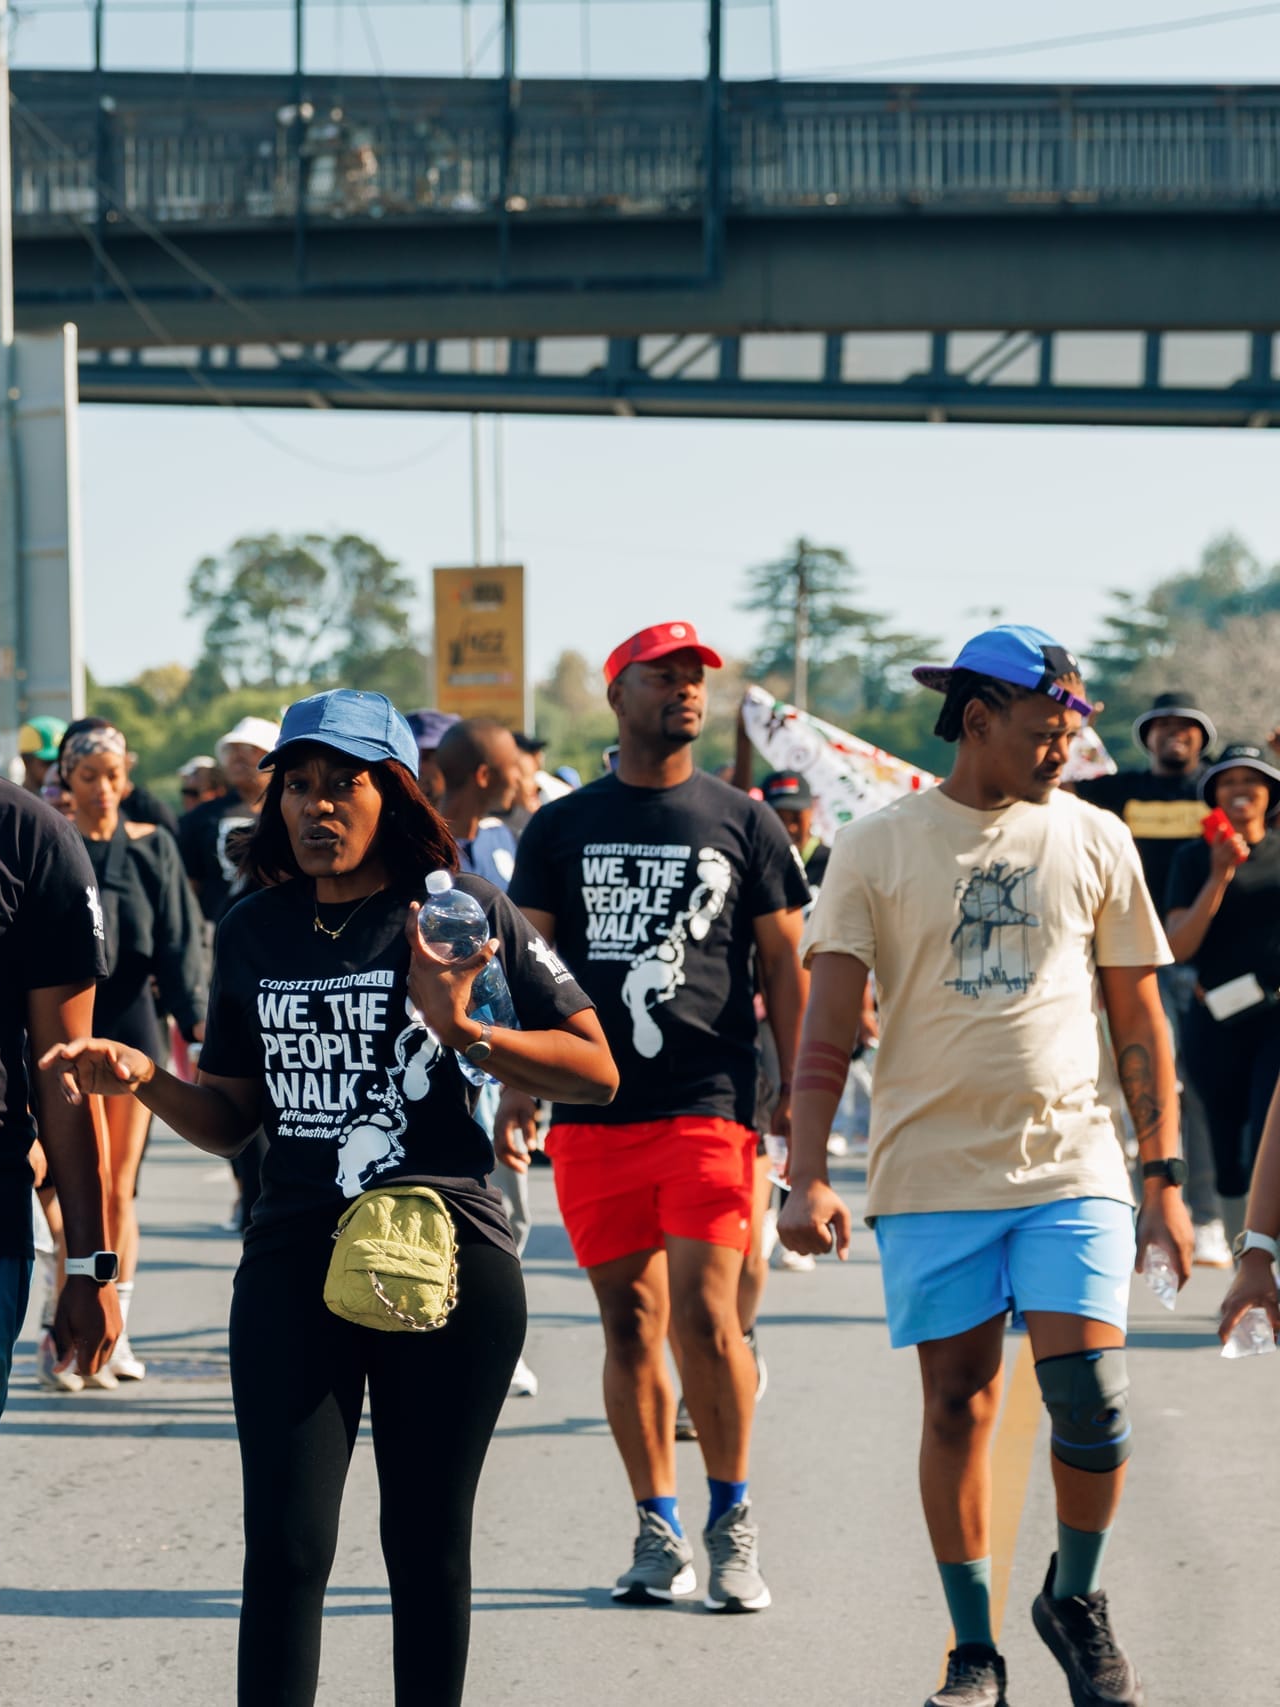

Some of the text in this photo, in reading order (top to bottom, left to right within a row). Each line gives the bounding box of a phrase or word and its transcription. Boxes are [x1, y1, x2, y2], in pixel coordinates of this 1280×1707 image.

[582, 857, 687, 889] WE, THE
[581, 886, 672, 915] PEOPLE
[257, 992, 389, 1034] WE, THE
[260, 1033, 376, 1072] PEOPLE
[265, 1072, 361, 1111] WALK
[278, 1123, 293, 1137] the
[280, 1109, 347, 1124] Affirmation of
